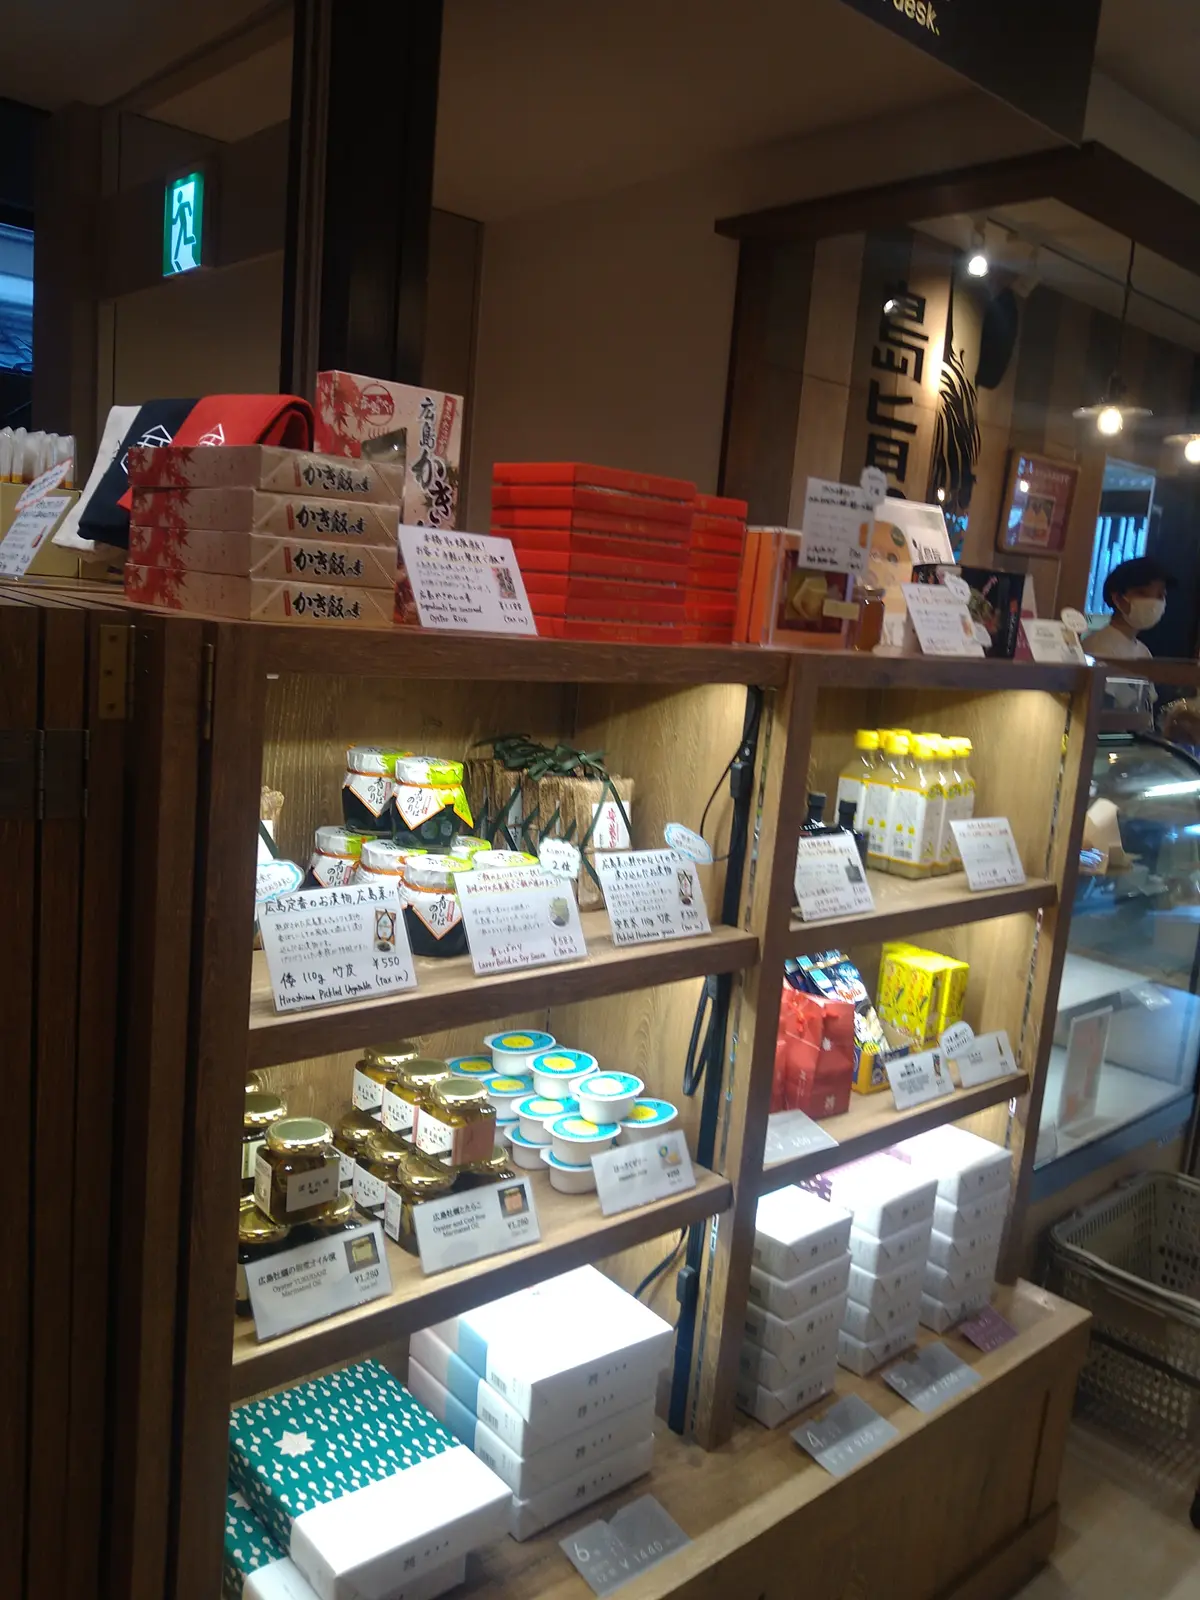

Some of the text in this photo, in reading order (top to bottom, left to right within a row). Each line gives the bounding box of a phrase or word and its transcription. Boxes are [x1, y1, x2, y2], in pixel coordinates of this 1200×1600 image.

[412, 397, 451, 527] 広島かき
[303, 463, 371, 492] かき飯の素
[296, 506, 366, 534] かき飯の素
[293, 549, 363, 577] かき飯の素
[293, 592, 361, 618] かき飯の素
[303, 972, 326, 985] 110g
[333, 963, 357, 979] 竹皮
[372, 956, 400, 969] ¥550
[279, 992, 315, 1007] Hiroshima
[318, 986, 343, 999] Pickled
